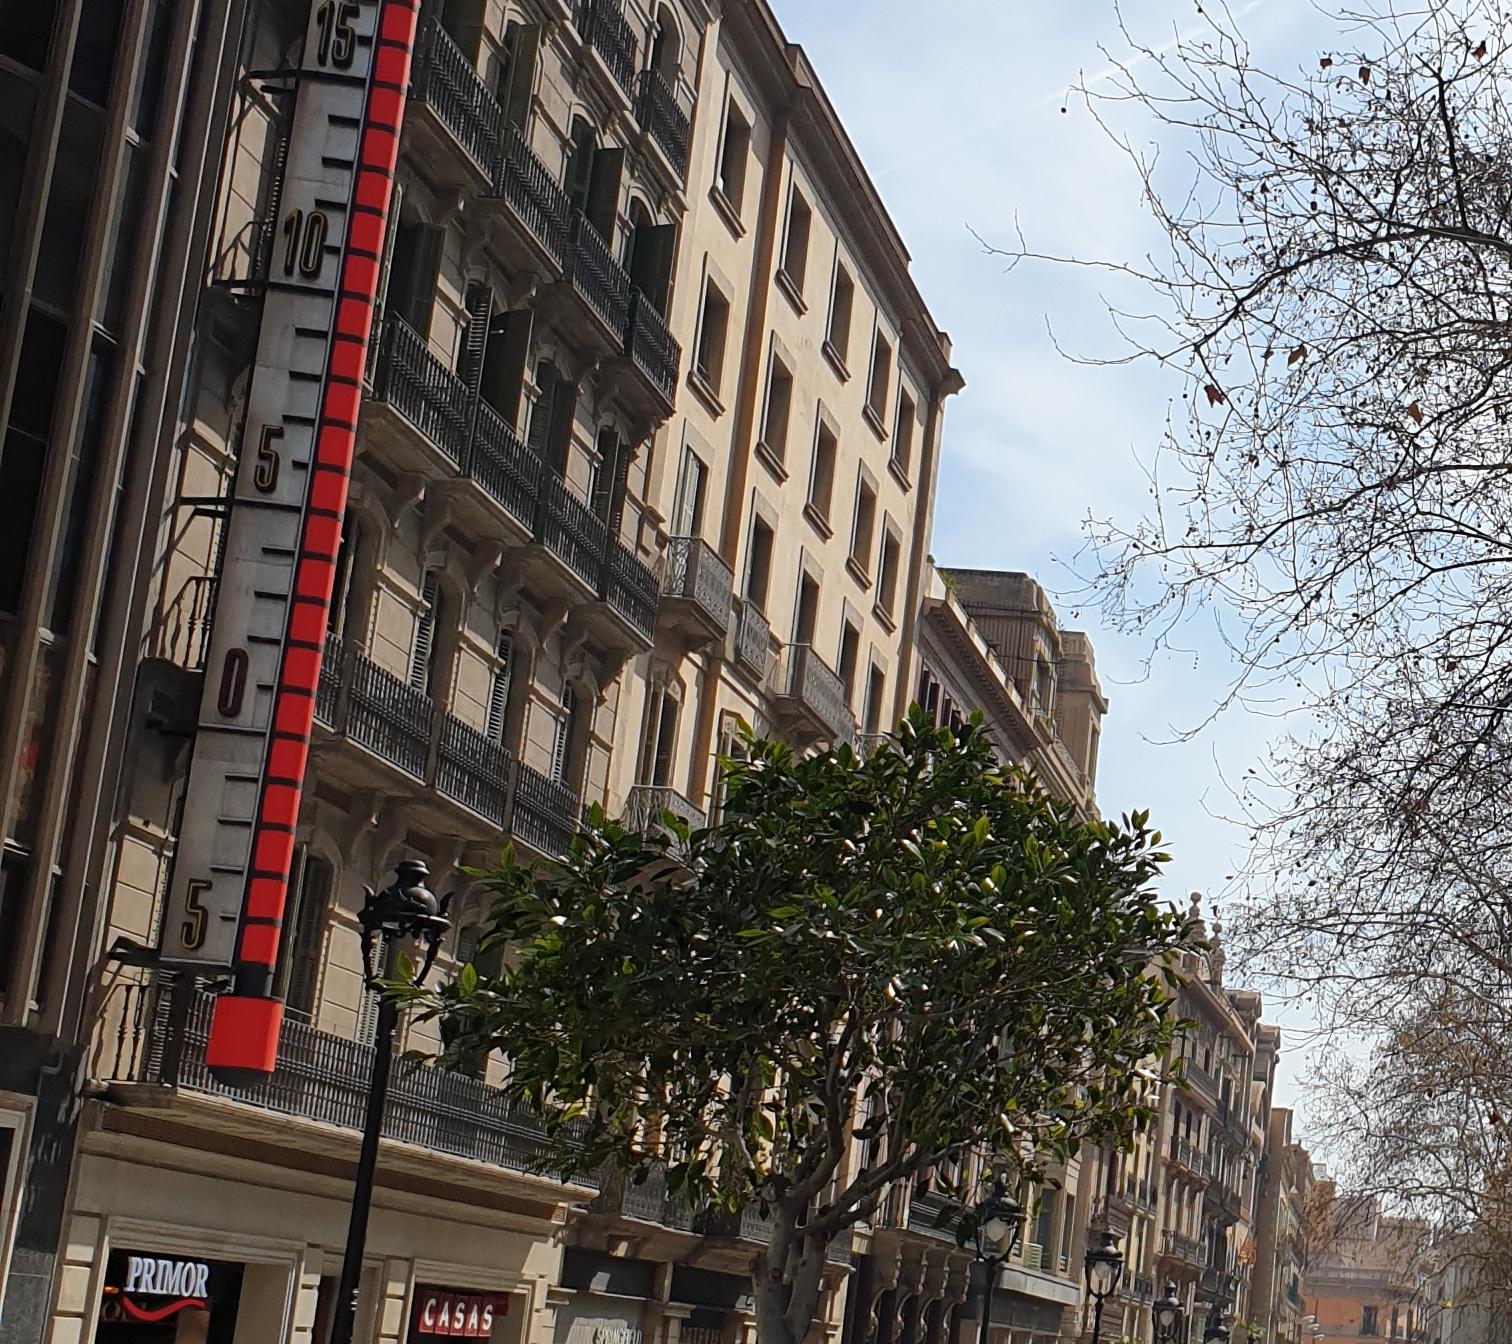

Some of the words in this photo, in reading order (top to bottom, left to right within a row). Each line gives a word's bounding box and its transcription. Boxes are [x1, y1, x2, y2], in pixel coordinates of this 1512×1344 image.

[317, 0, 360, 70] 15
[284, 208, 328, 278] 10
[254, 424, 285, 493] 5
[217, 648, 249, 717] 0
[180, 879, 213, 950] 5
[123, 1256, 210, 1298] PRIMOR
[423, 1297, 494, 1331] CASAS
